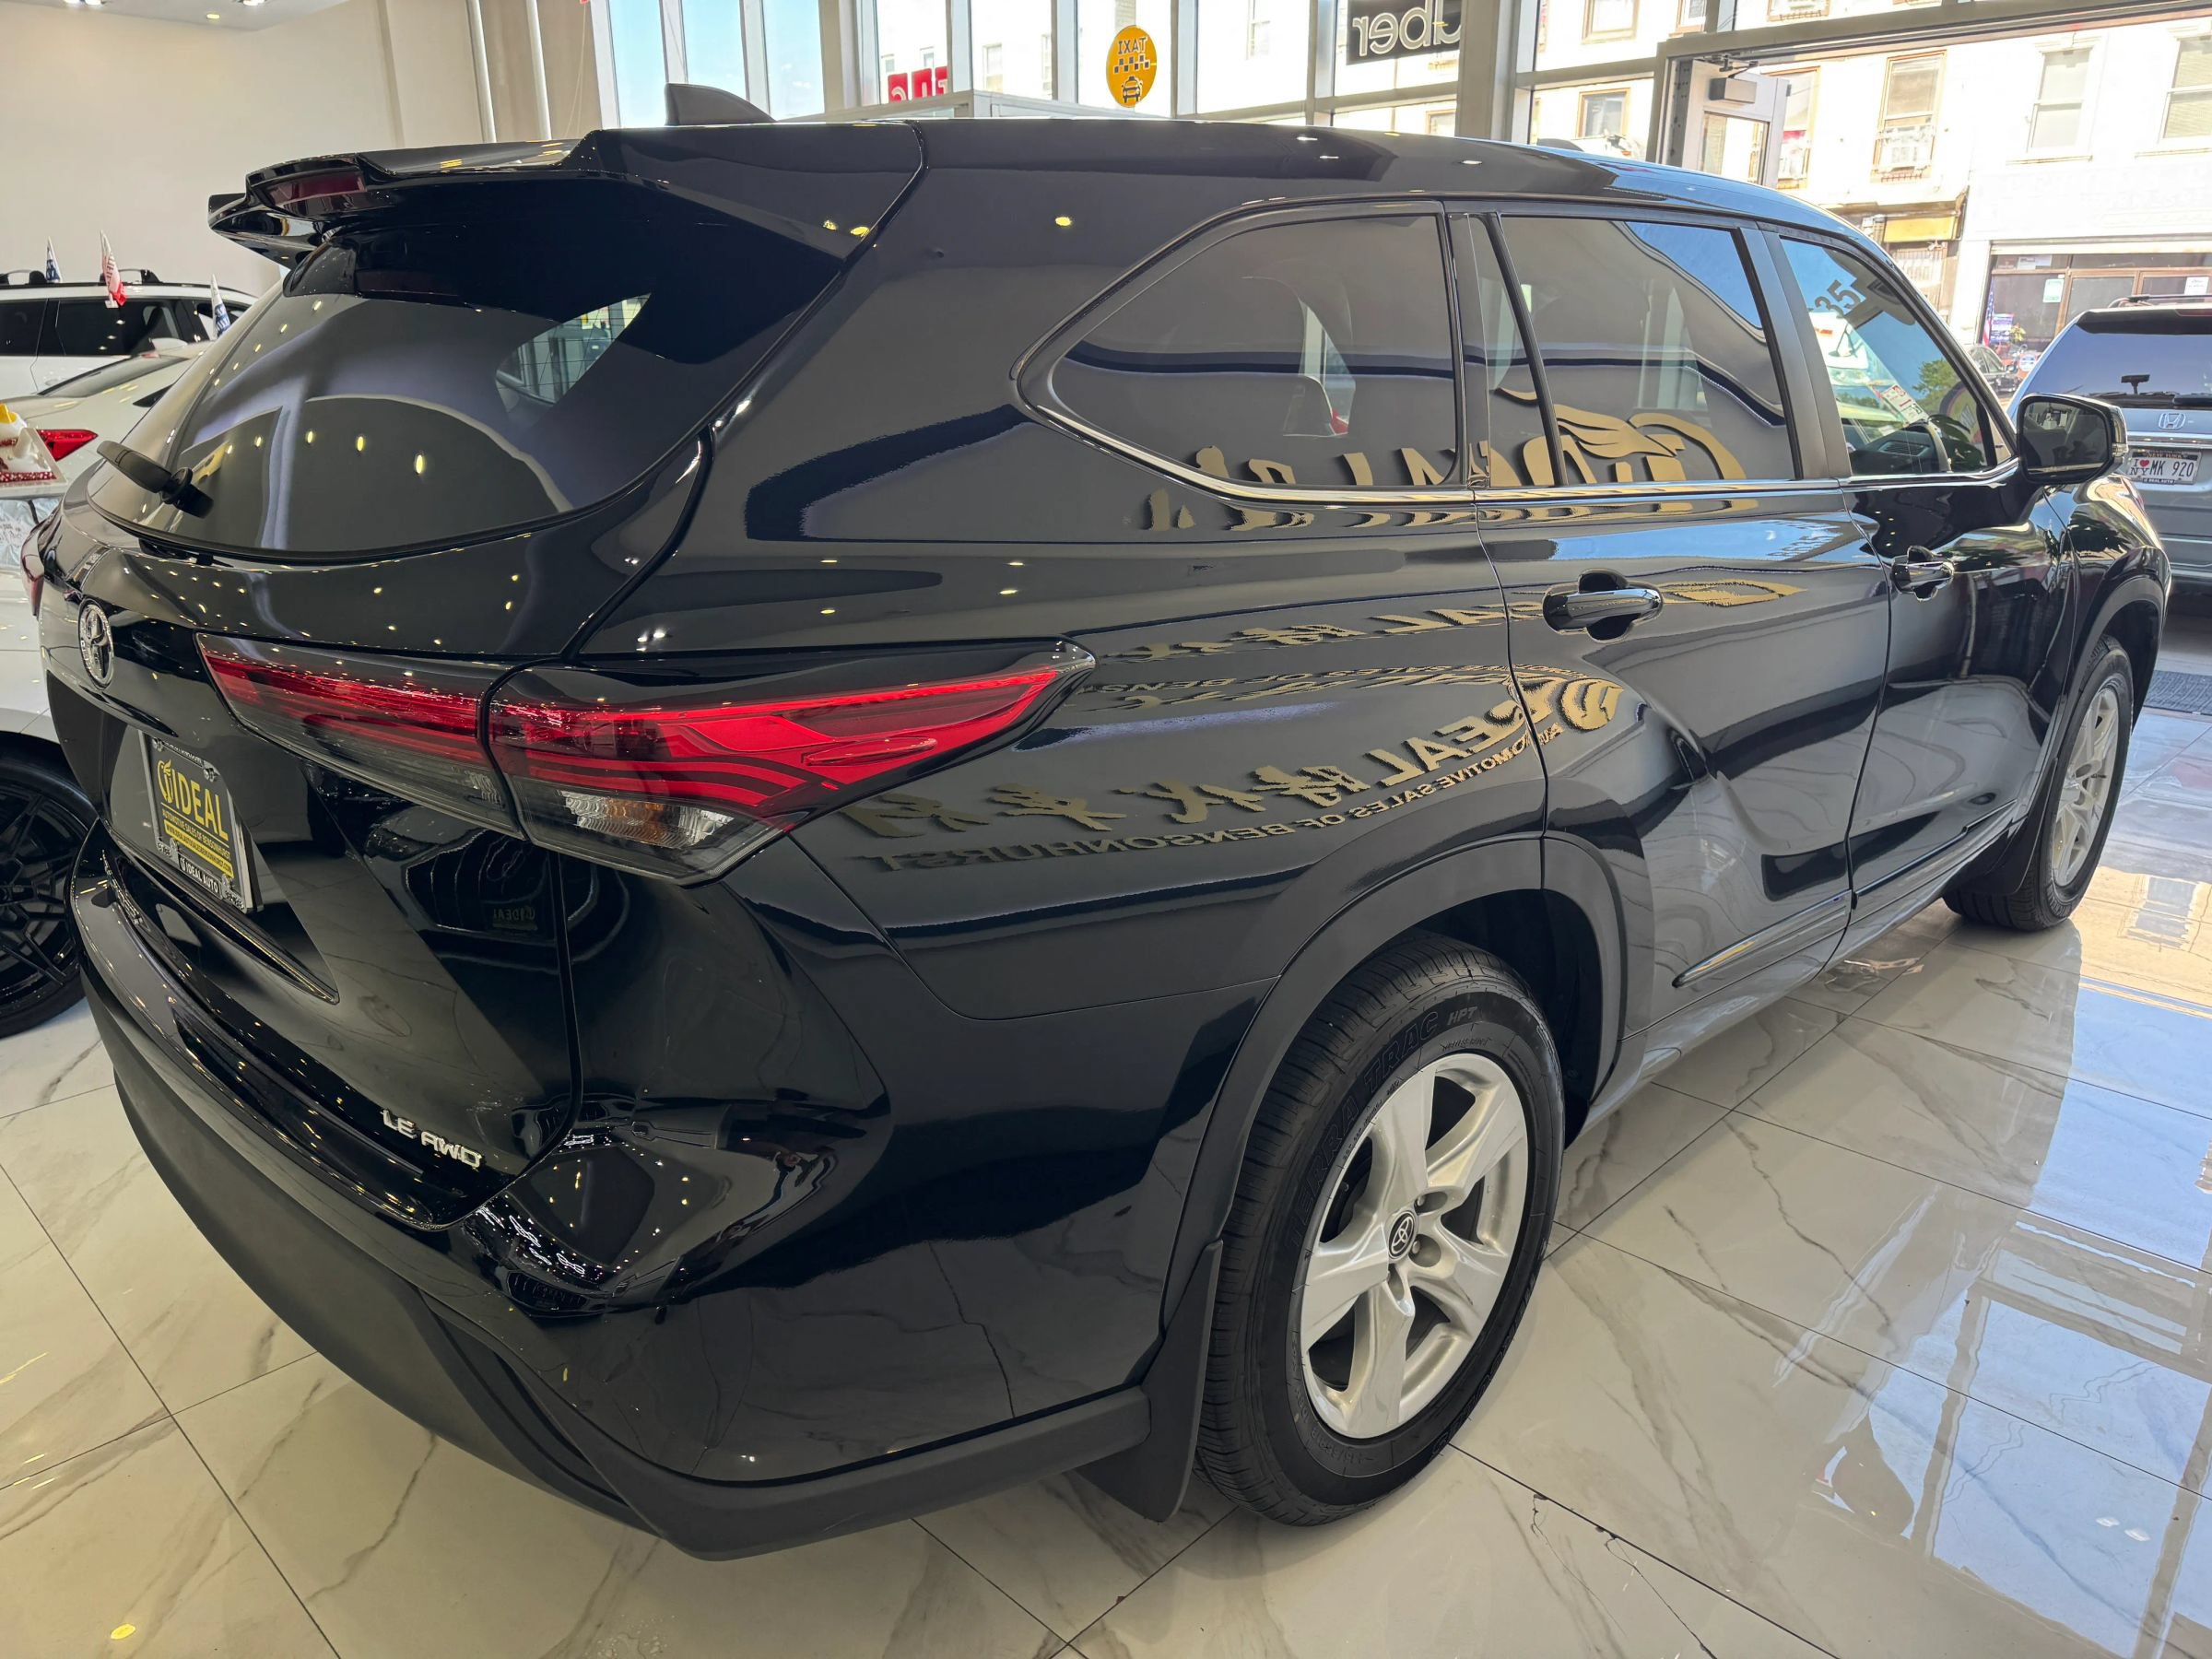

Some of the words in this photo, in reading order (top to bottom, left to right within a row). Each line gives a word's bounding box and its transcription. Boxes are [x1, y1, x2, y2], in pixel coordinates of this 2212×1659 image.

[2130, 466, 2149, 476] NY
[2149, 460, 2166, 476] MK
[2171, 462, 2194, 477] 920
[171, 768, 229, 841] IDEAL
[203, 875, 219, 894] AUTO
[1446, 1006, 1478, 1026] HPT
[382, 1109, 418, 1140] LE
[421, 1130, 483, 1169] AWD
